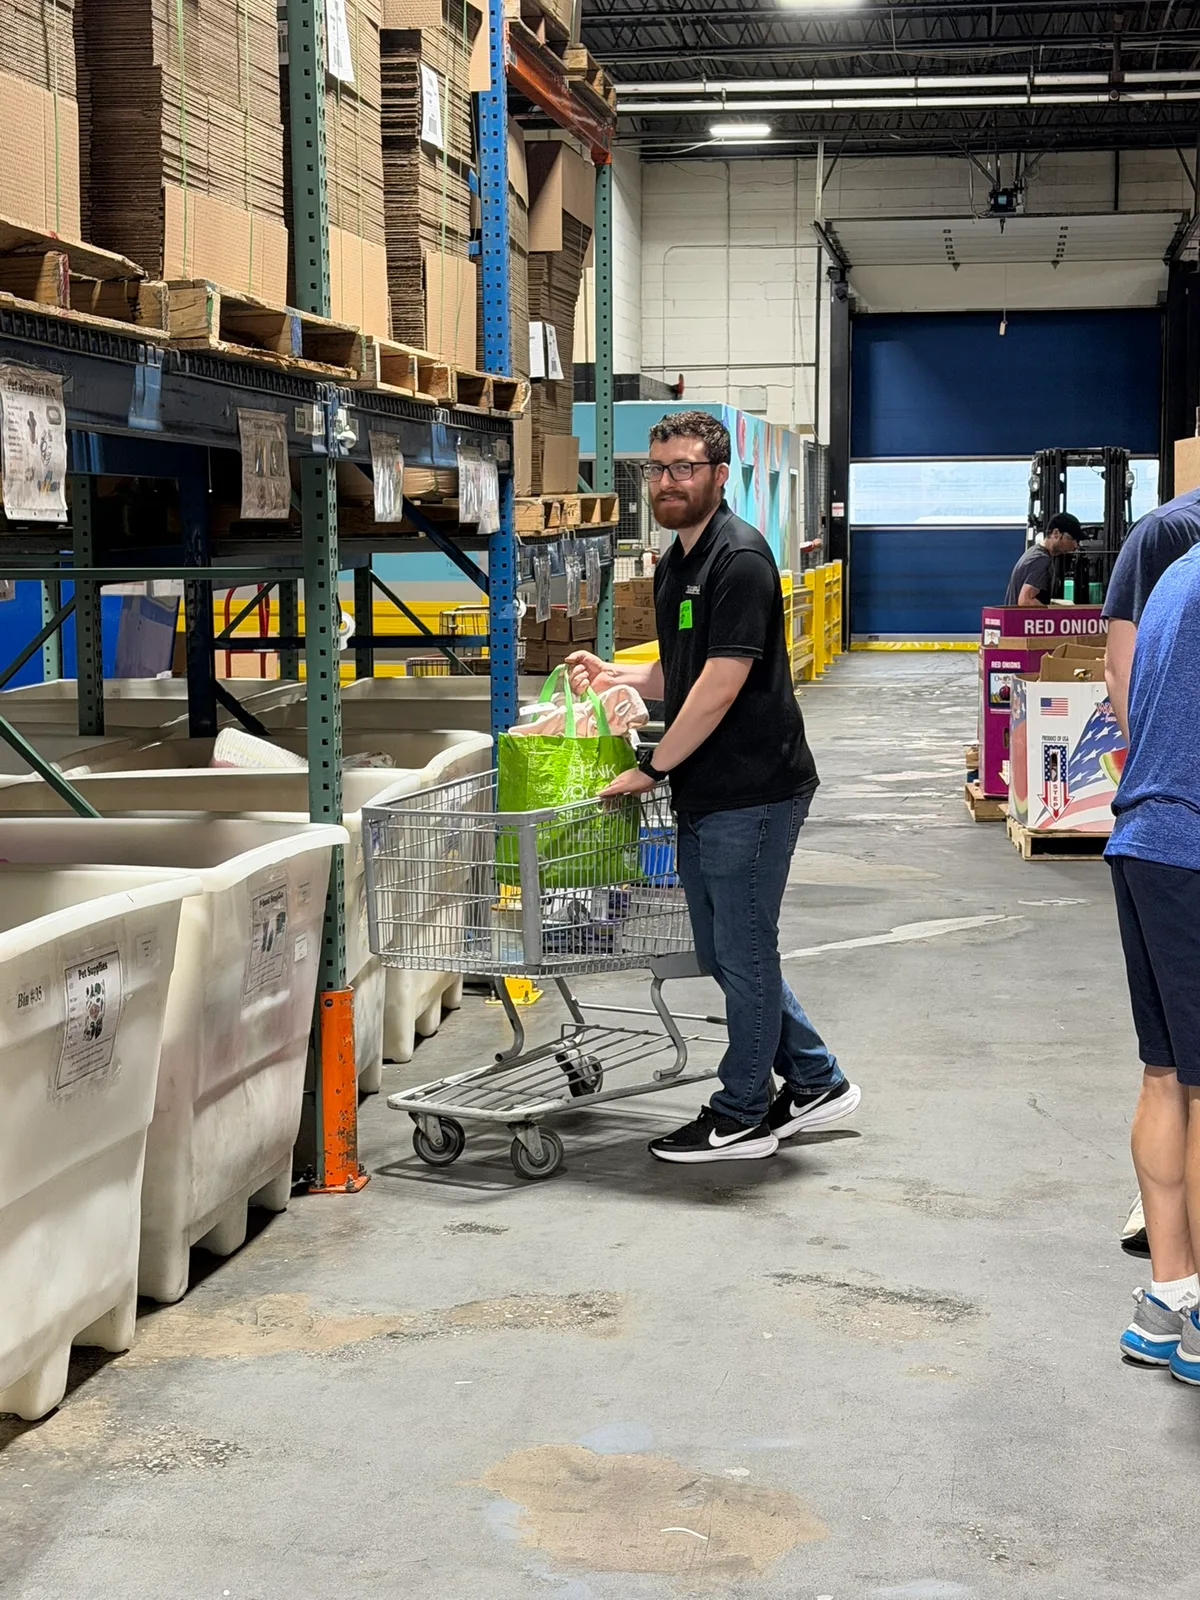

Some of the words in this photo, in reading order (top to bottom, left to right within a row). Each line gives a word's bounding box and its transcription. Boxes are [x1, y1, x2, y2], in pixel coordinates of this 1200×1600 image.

[8, 378, 18, 391] Pet
[18, 379, 45, 396] Supplies
[1024, 619, 1055, 635] RED
[1002, 661, 1021, 669] ONIONS
[78, 969, 87, 980] Pet
[87, 961, 108, 977] Supplies
[17, 992, 29, 1008] Bin
